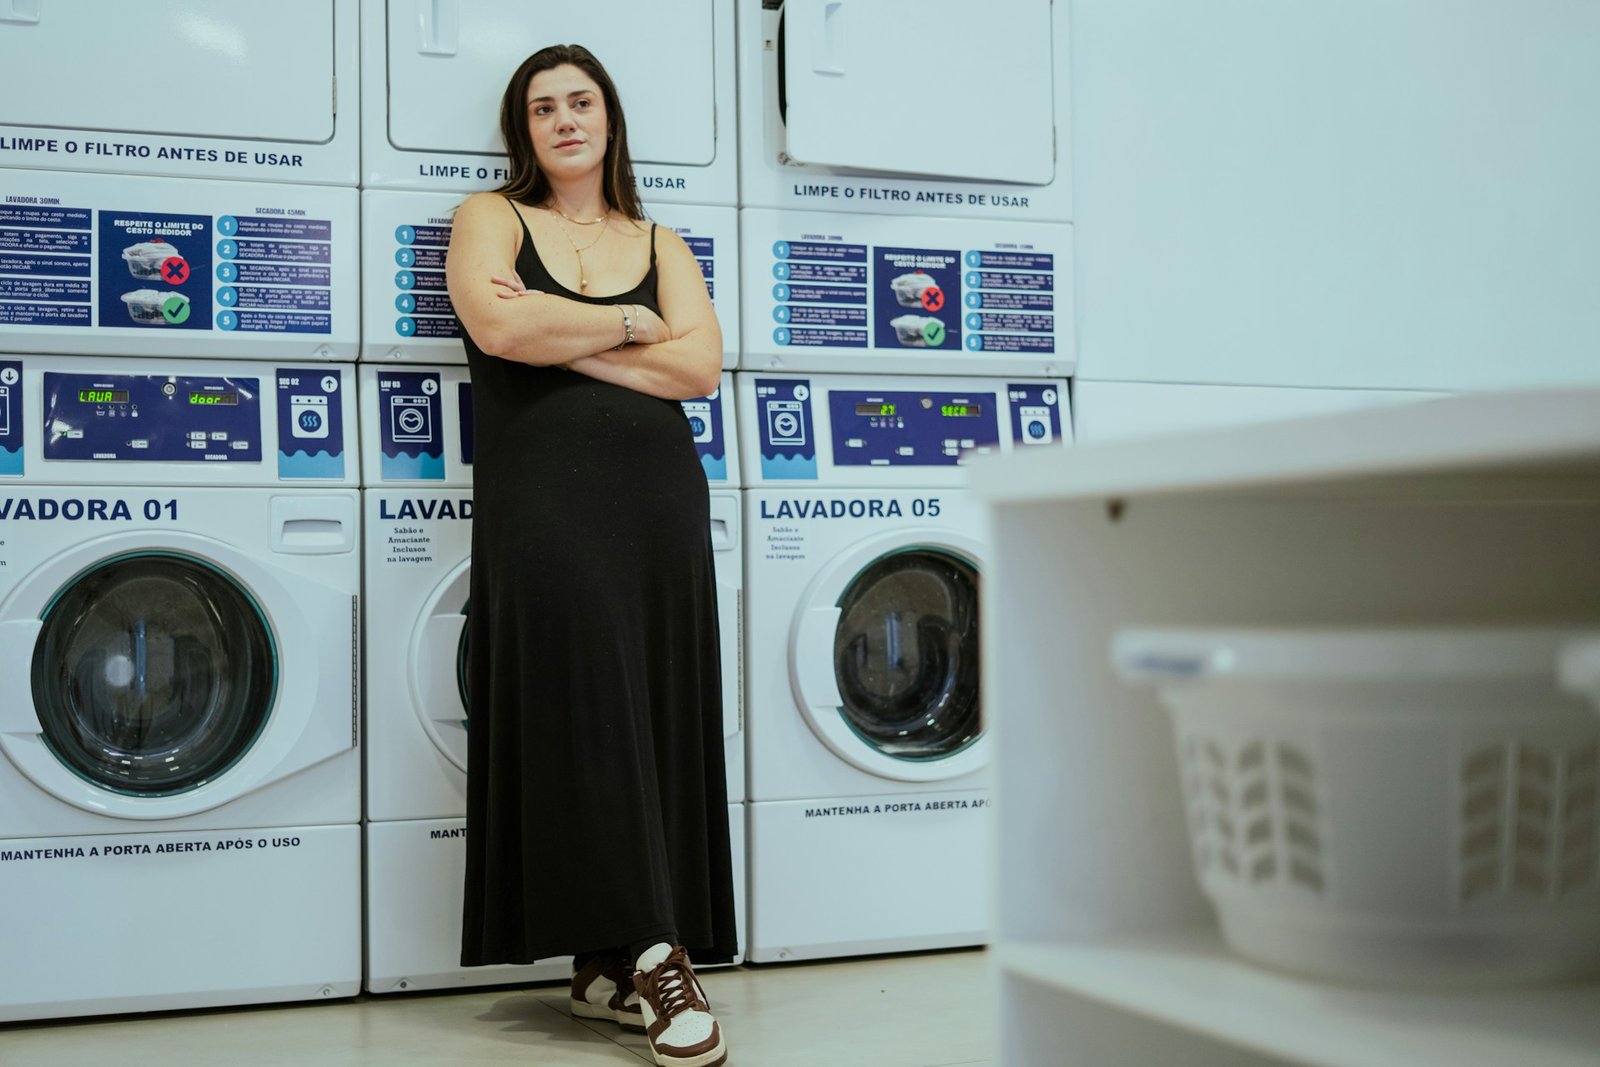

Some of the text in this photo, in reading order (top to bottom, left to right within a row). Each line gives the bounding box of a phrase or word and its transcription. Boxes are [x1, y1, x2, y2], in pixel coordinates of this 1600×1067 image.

[0, 136, 303, 167] LIMPE O FILTRO ANTES DE USAR
[420, 165, 470, 178] LIMPE
[477, 168, 487, 179] O
[644, 177, 685, 189] USAR
[794, 184, 1029, 208] LIMPE O FILTRO ANTES DE USAR
[224, 222, 230, 230] 1
[402, 231, 408, 239] 1
[223, 245, 230, 253] 2
[778, 246, 784, 254] 1
[402, 253, 408, 262] 2
[223, 268, 230, 277] 3
[778, 267, 784, 275] 2
[401, 276, 408, 284] 3
[223, 293, 230, 301] 4
[402, 299, 408, 308] 4
[778, 310, 784, 318] 4
[223, 316, 230, 325] 5
[402, 323, 408, 331] 5
[143, 499, 177, 521] 01
[761, 499, 940, 519] LAVADORA 05
[806, 804, 869, 818] MANTENHA
[874, 805, 881, 813] A
[885, 803, 921, 813] PORTA
[925, 800, 968, 810] ABERTA
[1, 836, 300, 861] MANTENHA A PORTA ABERTA APÓS O USO
